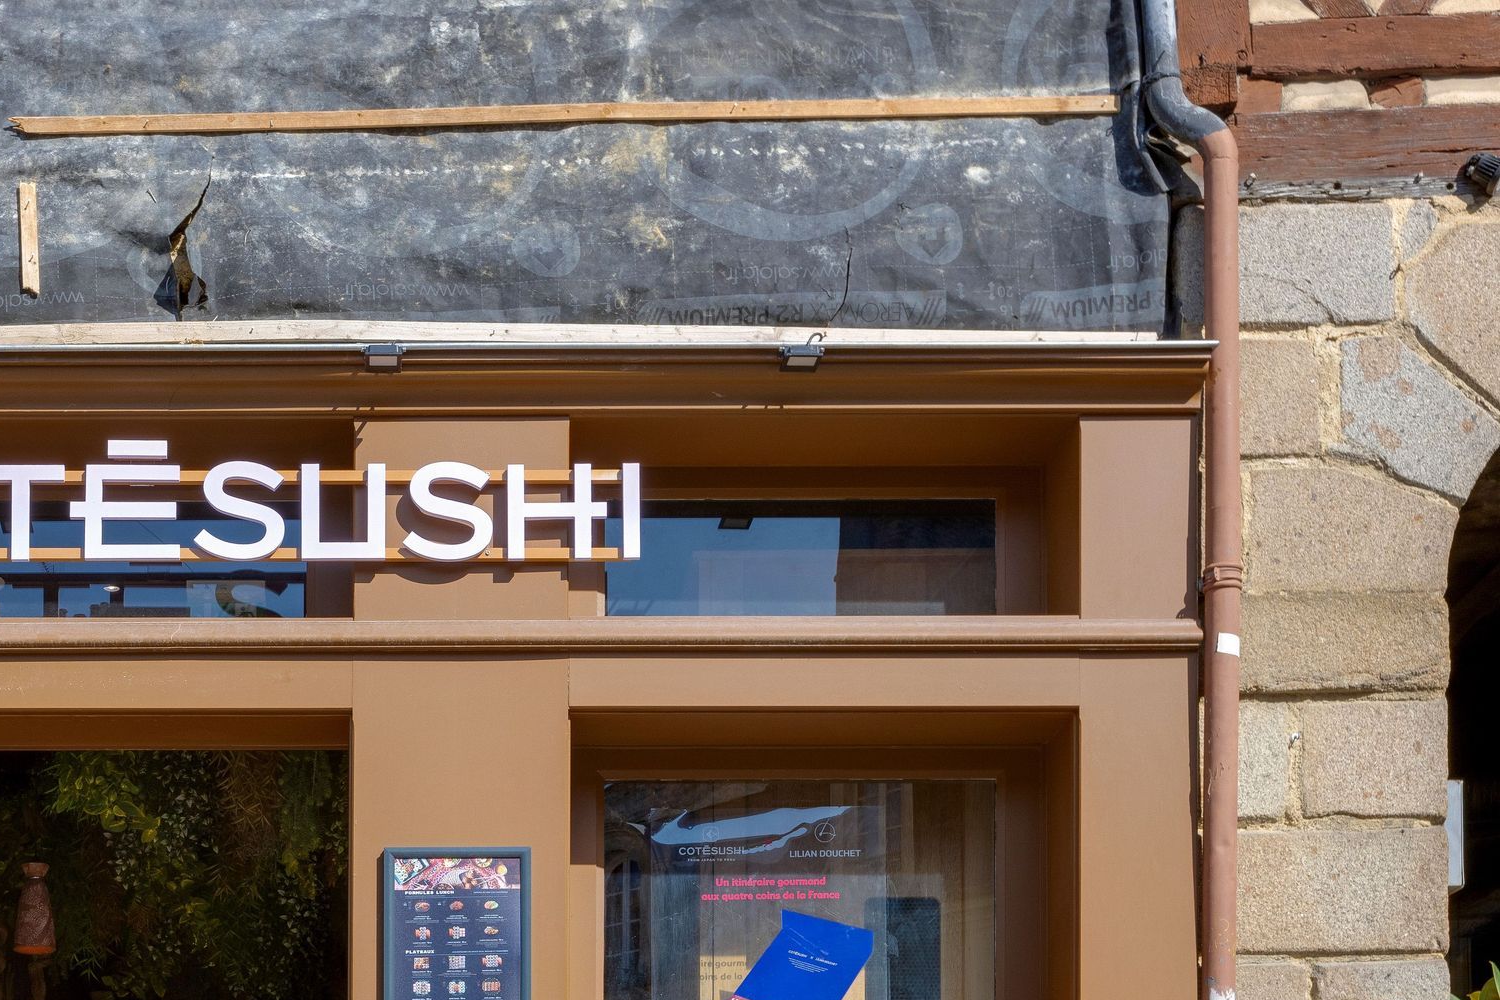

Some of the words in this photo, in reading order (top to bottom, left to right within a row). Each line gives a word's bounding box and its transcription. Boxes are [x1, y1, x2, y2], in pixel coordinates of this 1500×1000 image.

[1051, 290, 1151, 318] PREMIUM
[667, 306, 769, 325] PREMIUM
[777, 304, 803, 321] R2
[789, 850, 818, 858] LILIAN
[819, 849, 861, 858] DOUCHET
[715, 878, 729, 887] Un
[731, 877, 775, 887] itinéraire
[777, 876, 826, 888] gourmand
[721, 892, 753, 902] quatre
[755, 891, 780, 900] coins
[782, 891, 794, 900] de
[796, 890, 806, 899] la
[807, 889, 840, 899] France
